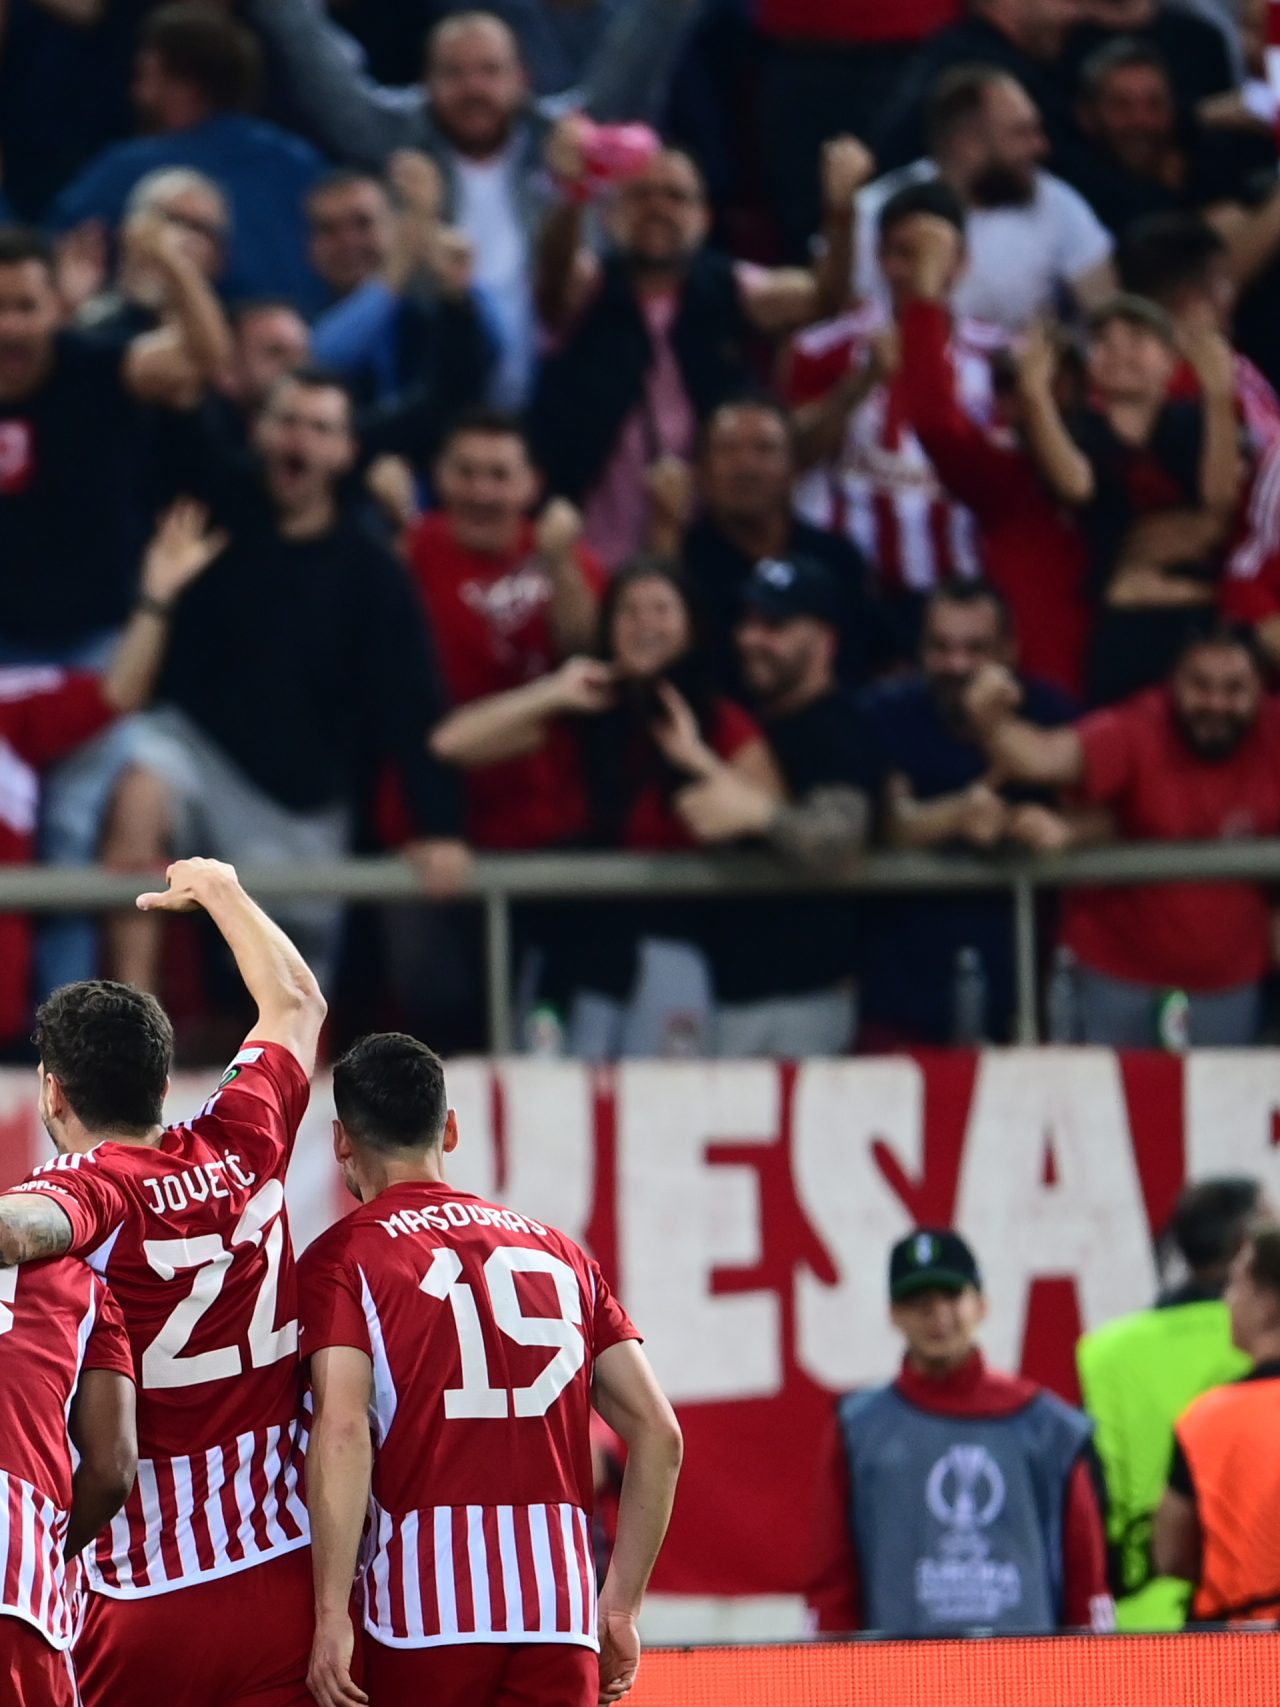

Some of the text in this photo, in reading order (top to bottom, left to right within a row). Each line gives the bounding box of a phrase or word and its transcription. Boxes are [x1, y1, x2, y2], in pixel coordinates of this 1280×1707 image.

[143, 1148, 256, 1214] JOVEĆ
[375, 1202, 548, 1239] MASOURAS
[142, 1178, 298, 1389] 22
[418, 1246, 586, 1420] 19
